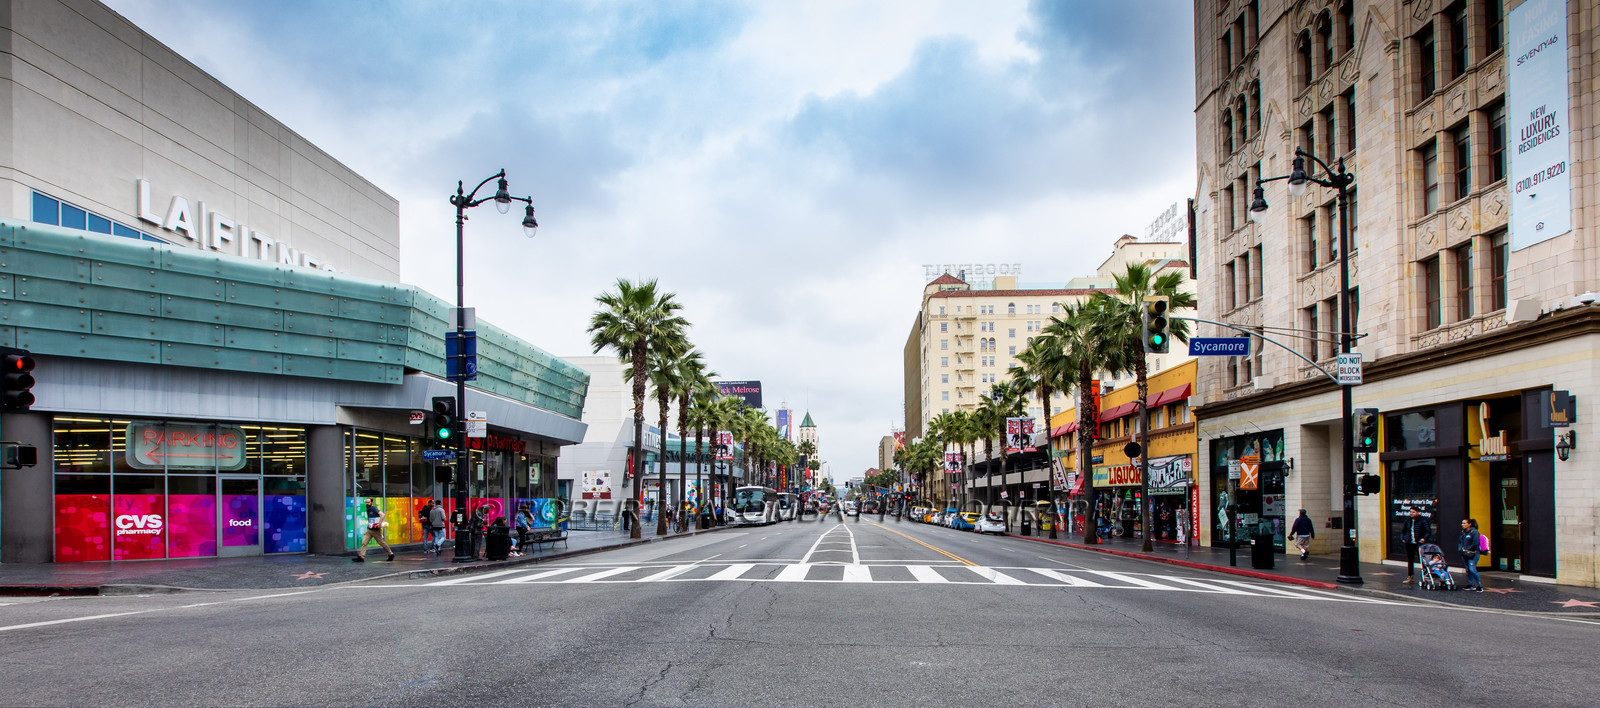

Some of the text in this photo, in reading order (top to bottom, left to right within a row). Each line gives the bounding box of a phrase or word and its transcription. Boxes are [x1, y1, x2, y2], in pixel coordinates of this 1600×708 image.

[1516, 34, 1558, 66] SEVENTY46
[1530, 104, 1546, 121] NEW
[1521, 111, 1556, 141] LUXURY
[1518, 125, 1560, 155] RESIDENCES
[1515, 161, 1566, 194] (310).917.9220
[1194, 341, 1245, 353] Sycamore
[733, 386, 760, 394] Melrose
[144, 431, 237, 449] PARKING
[116, 514, 162, 528] CVS
[229, 519, 251, 527] food
[117, 528, 162, 536] pharmacy
